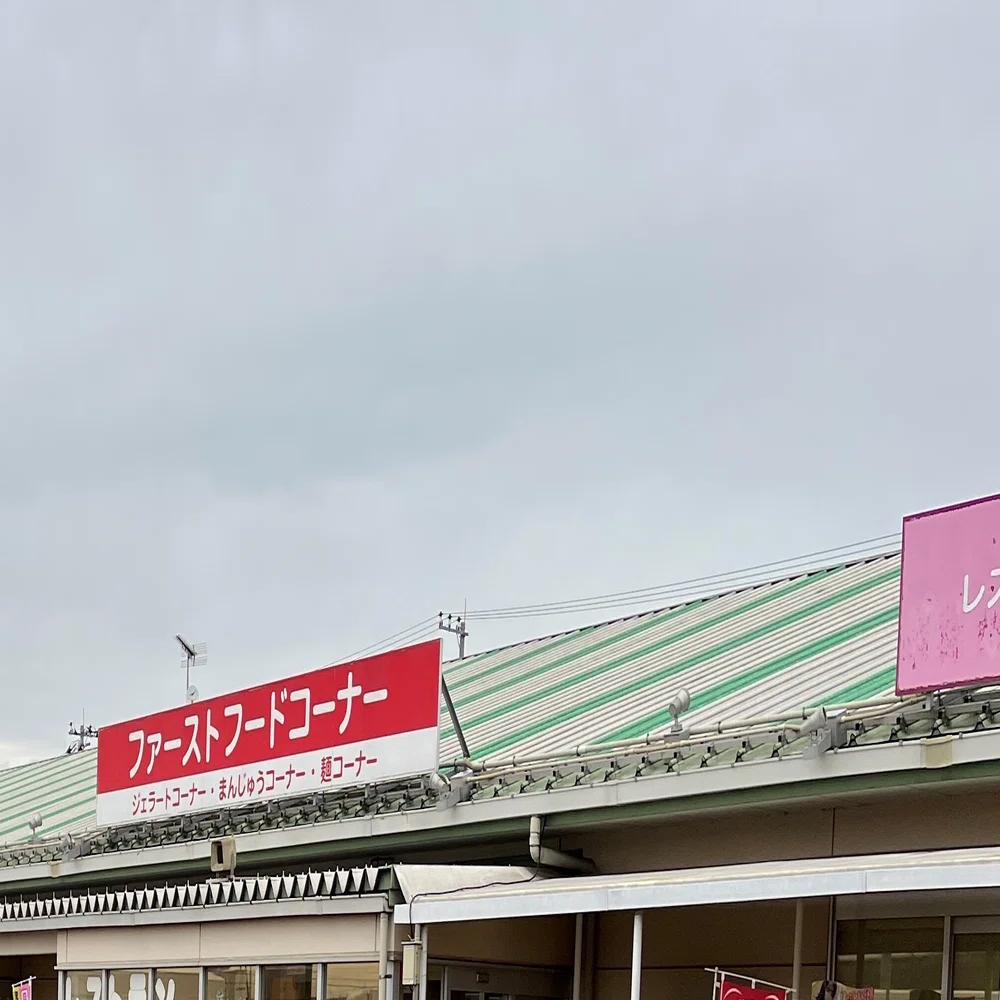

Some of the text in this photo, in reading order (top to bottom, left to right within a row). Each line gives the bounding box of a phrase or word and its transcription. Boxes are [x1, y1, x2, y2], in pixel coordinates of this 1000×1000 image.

[128, 671, 388, 779] ファーストフードコーナー
